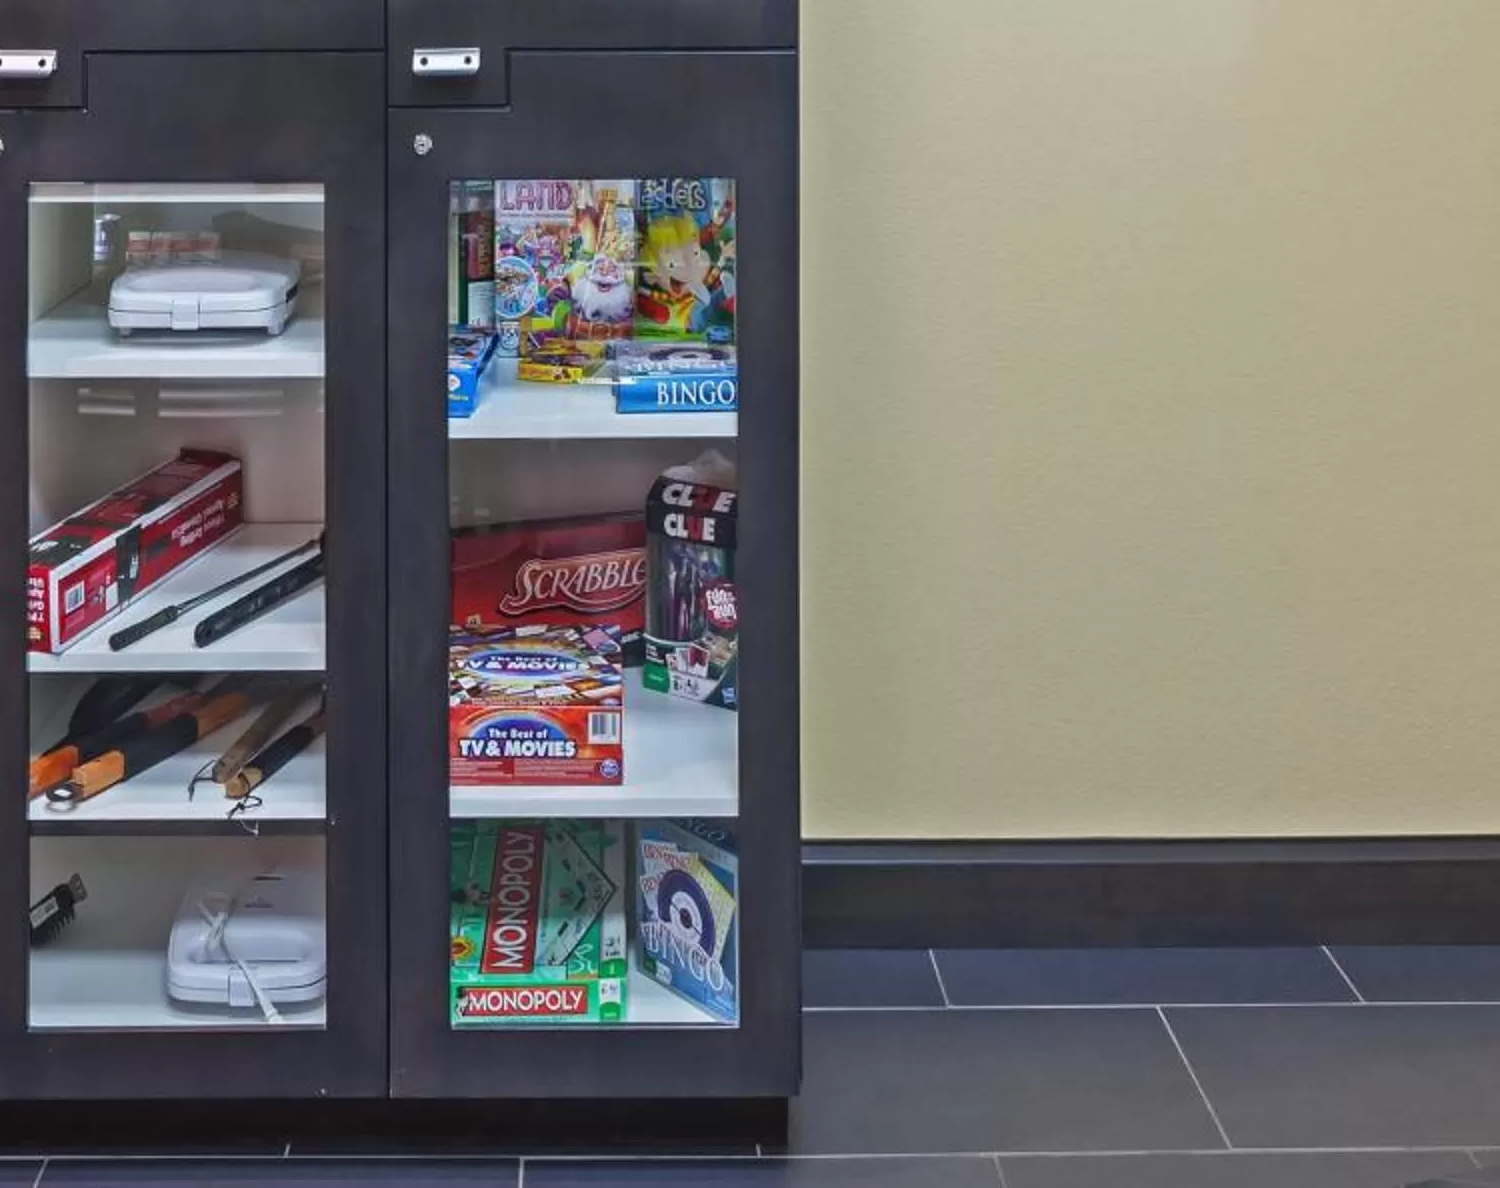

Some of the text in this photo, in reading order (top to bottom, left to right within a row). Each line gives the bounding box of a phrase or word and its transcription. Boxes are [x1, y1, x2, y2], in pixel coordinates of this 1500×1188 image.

[500, 182, 573, 210] LAND
[657, 379, 735, 405] BINGO
[662, 483, 736, 513] CLUE
[663, 512, 716, 542] CLUE
[510, 556, 645, 606] SCRABBLE
[488, 727, 548, 739] The Best of
[460, 740, 576, 757] TV & MOVIES
[490, 831, 535, 968] MONOPOLY
[469, 990, 584, 1012] MONOPOLY
